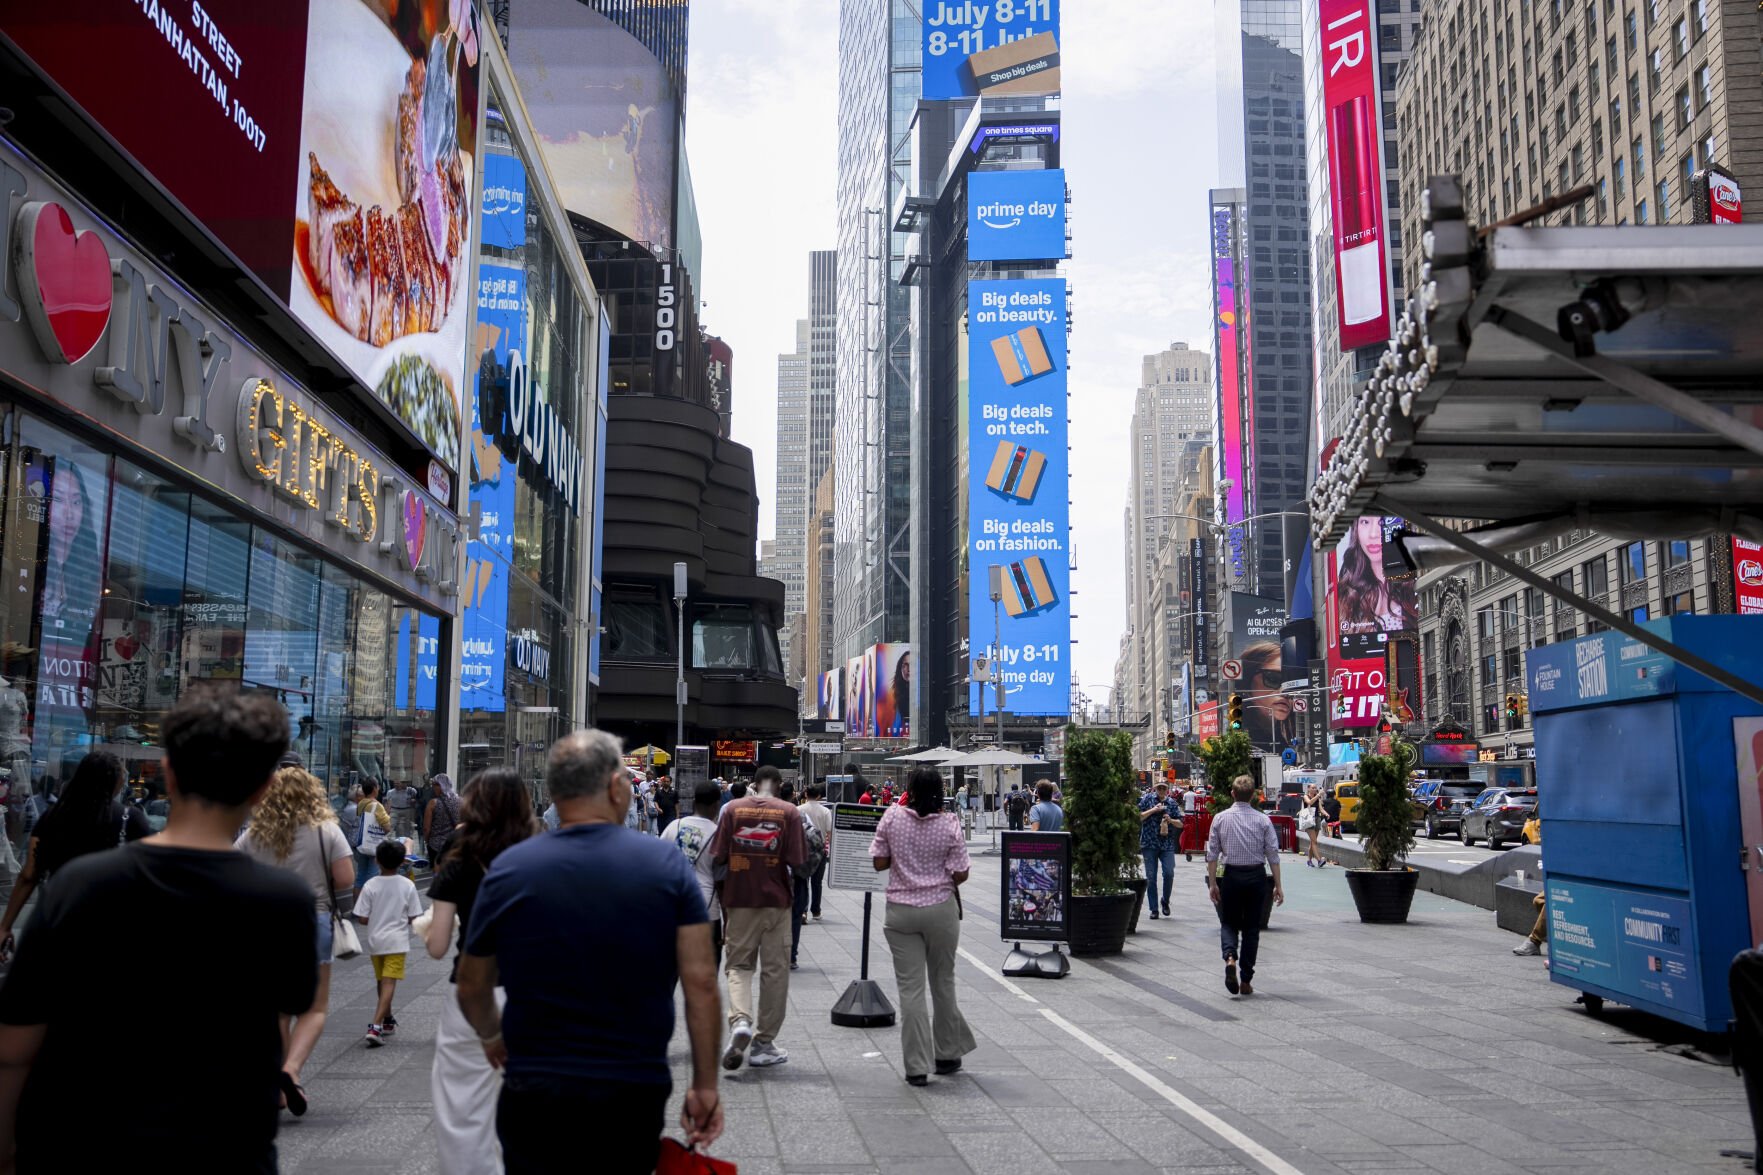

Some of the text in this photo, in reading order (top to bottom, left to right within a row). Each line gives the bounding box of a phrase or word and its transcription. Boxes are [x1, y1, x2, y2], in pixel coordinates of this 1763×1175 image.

[928, 0, 1050, 29] July 8-11
[192, 0, 242, 79] STREET
[929, 30, 983, 56] 8-11
[991, 60, 1048, 83] Shop big deals
[233, 99, 266, 152] 10017
[1025, 126, 1053, 134] square
[977, 200, 1057, 220] prime day
[1345, 229, 1372, 244] TIRTIR
[655, 263, 674, 350] 1500
[982, 291, 1052, 309] Big deals
[976, 308, 1058, 324] on beauty.
[982, 404, 1053, 421] Big deals
[508, 349, 584, 514] OLD NAVY
[986, 421, 1049, 435] on tech.
[240, 378, 377, 543] GIFTS
[983, 519, 1054, 537] Big deals
[975, 536, 1063, 551] on fashion.
[516, 638, 531, 671] OLD
[531, 648, 550, 681] NAVY
[1023, 645, 1059, 662] 8-11
[1575, 638, 1605, 668] RECHARGE
[986, 669, 1055, 685] ime day
[1540, 680, 1555, 691] HOUSE
[1578, 655, 1608, 699] STATION
[1312, 668, 1320, 712] SQUARE
[1314, 723, 1322, 757] TIMES
